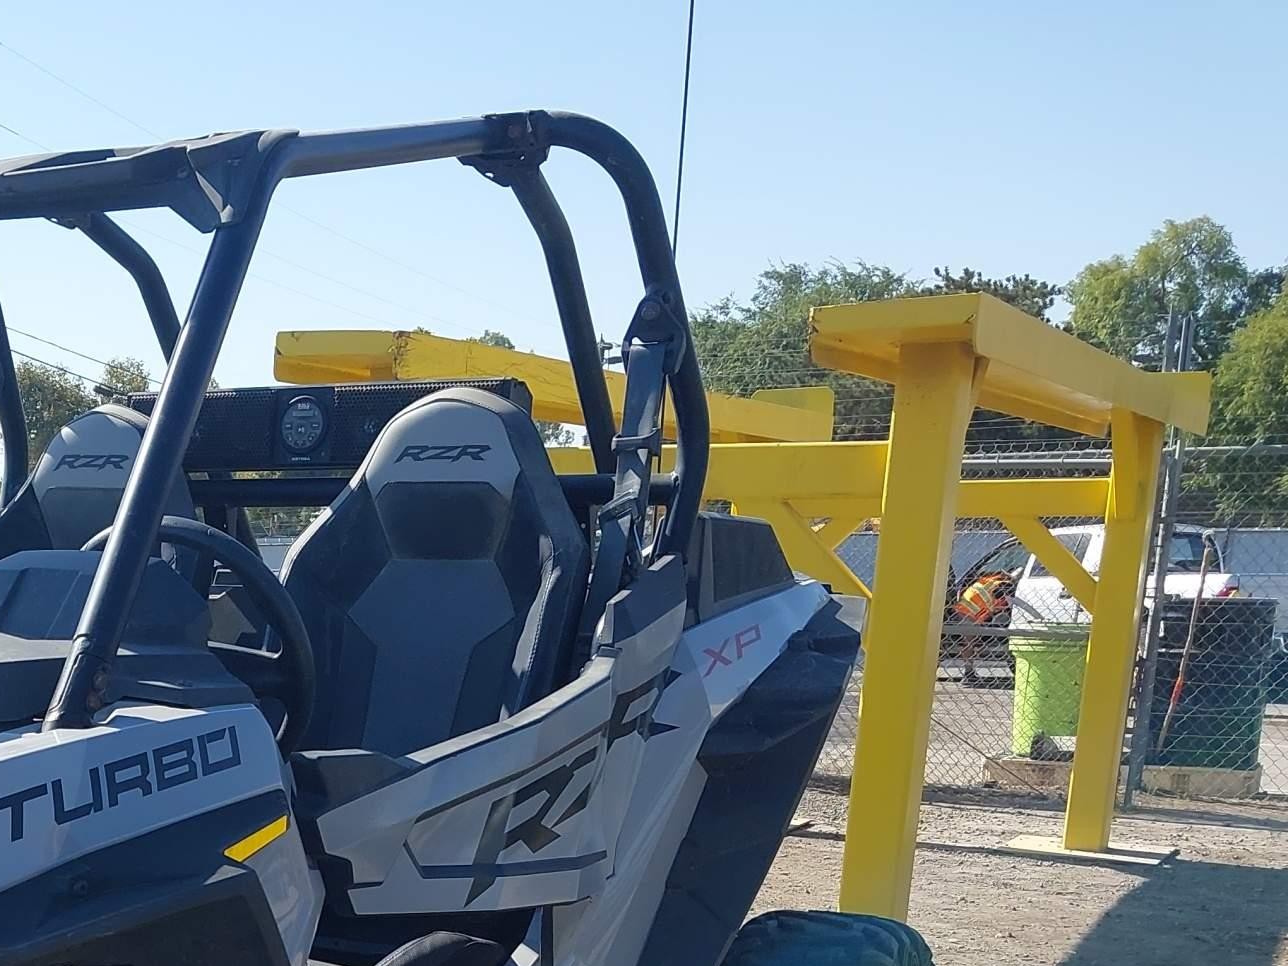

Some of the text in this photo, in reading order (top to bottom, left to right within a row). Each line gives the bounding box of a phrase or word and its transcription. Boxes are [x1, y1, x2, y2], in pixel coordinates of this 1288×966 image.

[54, 454, 129, 472] RZR
[393, 445, 492, 464] RZR
[702, 624, 761, 679] XP
